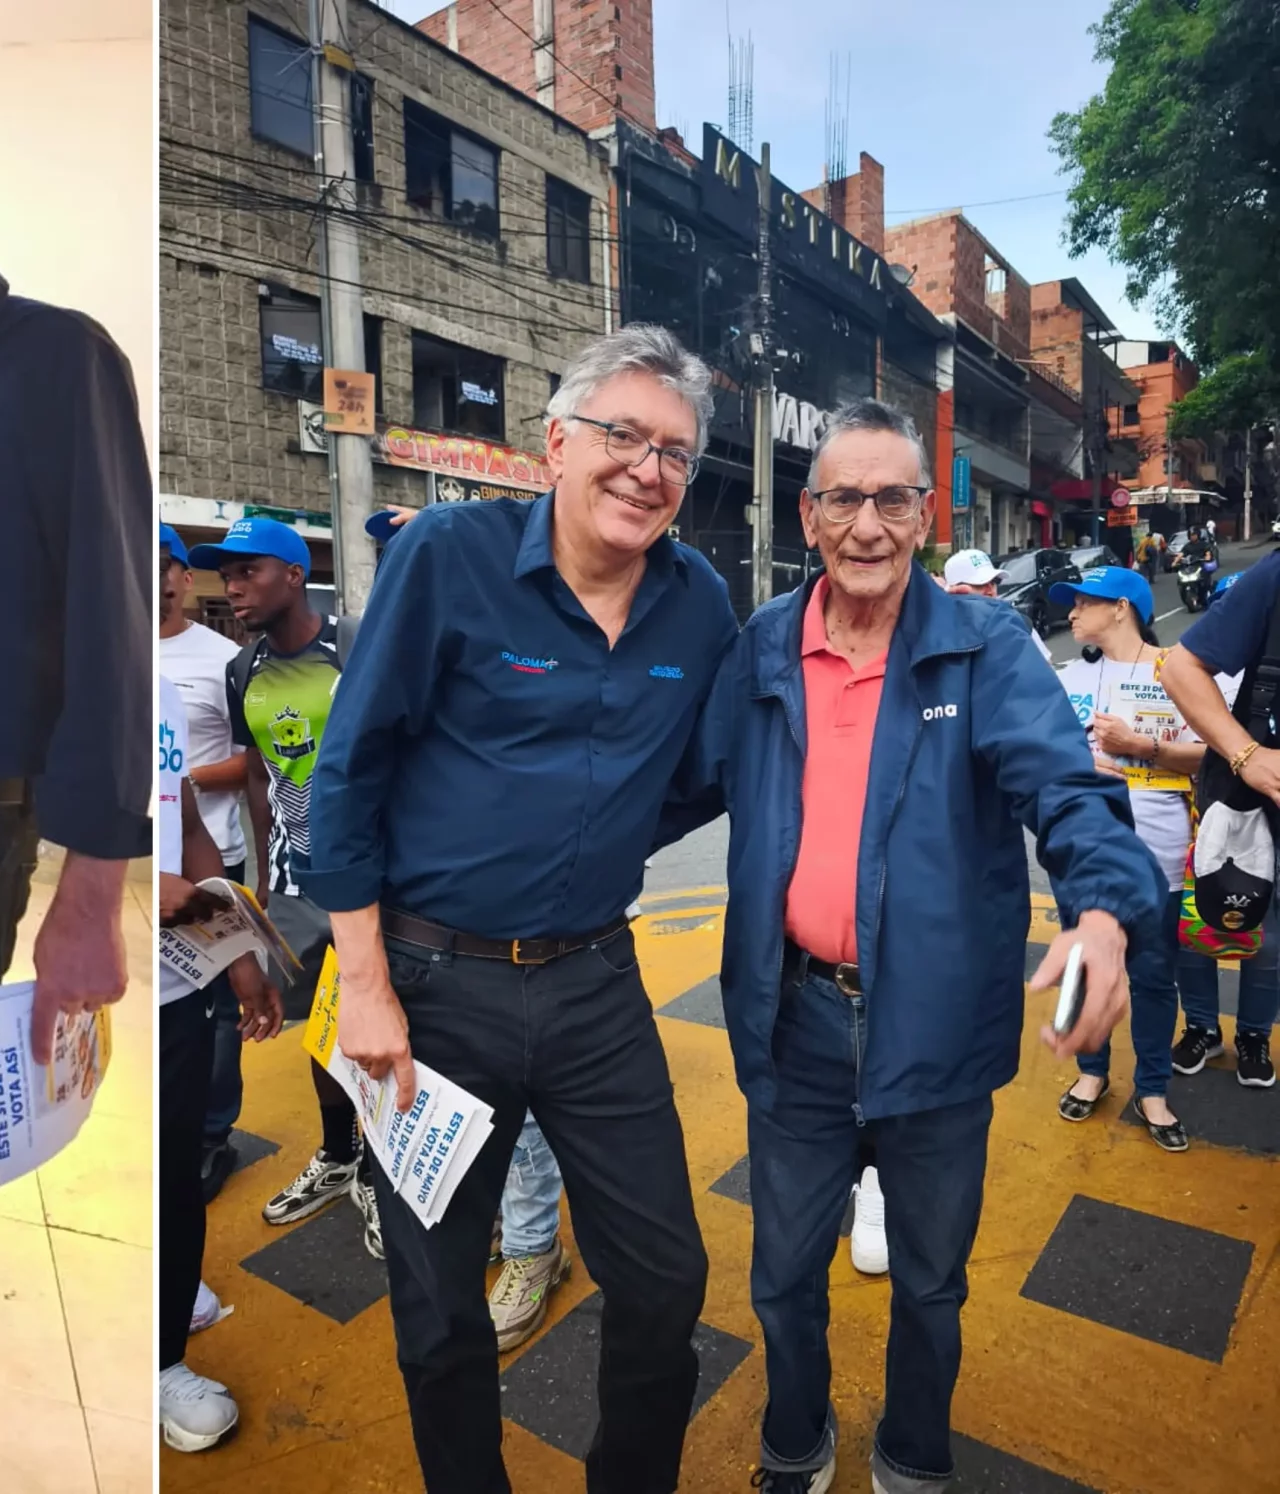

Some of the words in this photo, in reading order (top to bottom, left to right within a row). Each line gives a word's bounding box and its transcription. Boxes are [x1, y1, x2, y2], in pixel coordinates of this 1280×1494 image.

[1121, 683, 1141, 691] ESTE
[1135, 692, 1157, 700] VOTA
[174, 943, 198, 961] VOTA
[180, 961, 203, 980] ESTE
[0, 1047, 20, 1075] ASÍ
[9, 1079, 24, 1126] VOTA
[410, 1089, 430, 1122] ESTE
[391, 1111, 404, 1133] OTA
[405, 1121, 416, 1134] 31
[442, 1111, 464, 1145] ESTE
[398, 1135, 410, 1151] DE
[420, 1126, 441, 1159] VOTA
[436, 1142, 450, 1157] 31
[390, 1149, 405, 1178] MAYO
[429, 1155, 443, 1176] DE
[417, 1173, 436, 1204] MAYO
